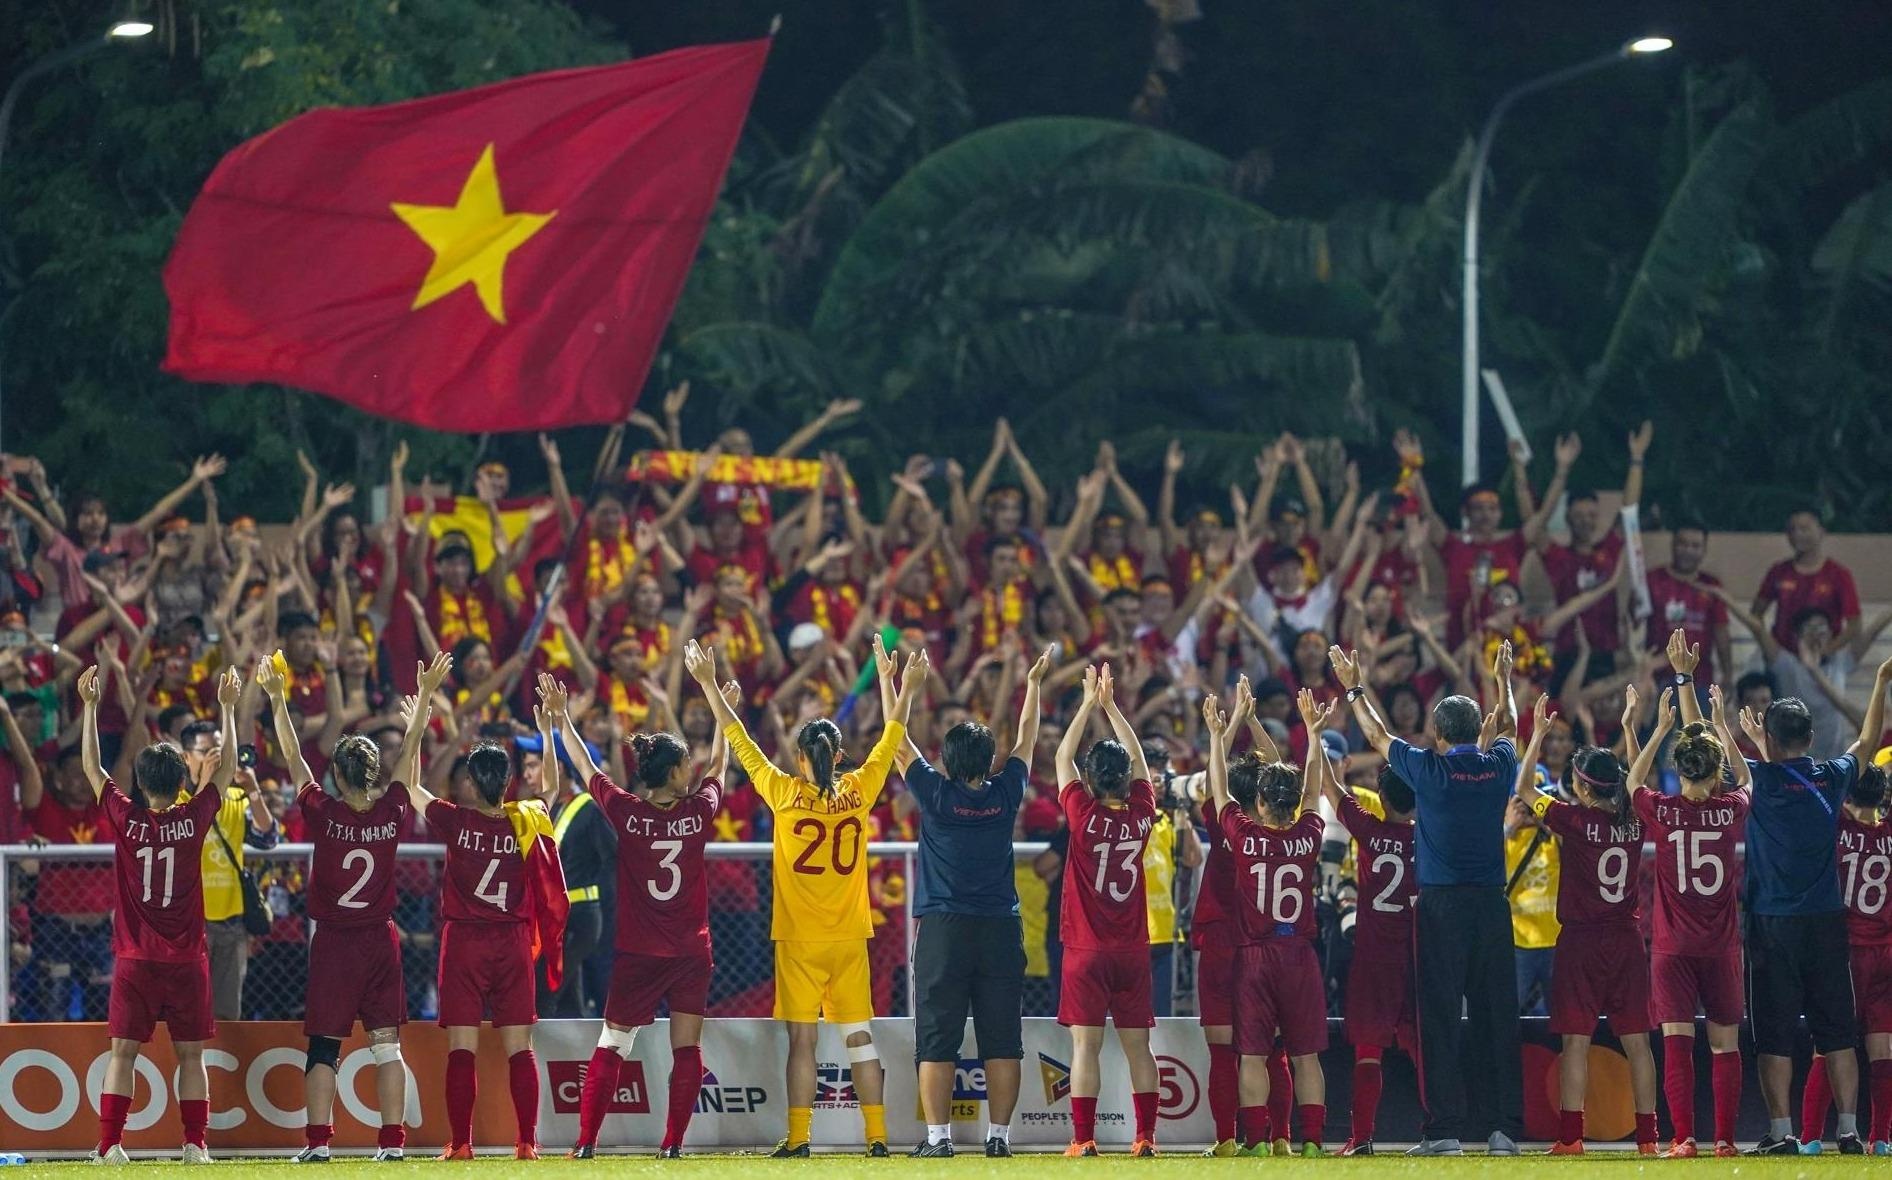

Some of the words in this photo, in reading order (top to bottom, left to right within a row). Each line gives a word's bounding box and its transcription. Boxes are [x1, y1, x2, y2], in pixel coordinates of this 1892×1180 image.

[626, 814, 658, 837] C.T.
[667, 814, 703, 837] KIEU
[827, 790, 862, 814] HANG
[126, 819, 150, 843] T.T.
[159, 818, 195, 843] THAO
[326, 818, 356, 842] T.T.H.
[361, 821, 397, 843] NHUNG
[457, 827, 485, 852] H.T.
[793, 815, 862, 876] 20
[1282, 836, 1315, 857] VAN
[1586, 823, 1602, 843] H.
[1840, 829, 1871, 854] N.T.
[136, 846, 175, 908] 11
[337, 848, 375, 909] 2
[473, 858, 508, 912] 4
[647, 840, 683, 901] 3
[1093, 839, 1143, 903] 13
[1371, 853, 1419, 913] 2
[1597, 846, 1629, 904] 9
[1667, 829, 1725, 896] 15
[1841, 852, 1892, 915] 18
[1249, 862, 1304, 924] 16
[952, 1067, 987, 1092] ne
[1158, 1067, 1184, 1109] 5
[1021, 1112, 1068, 1121] PEOPLE'S
[1069, 1112, 1126, 1121] TVISION
